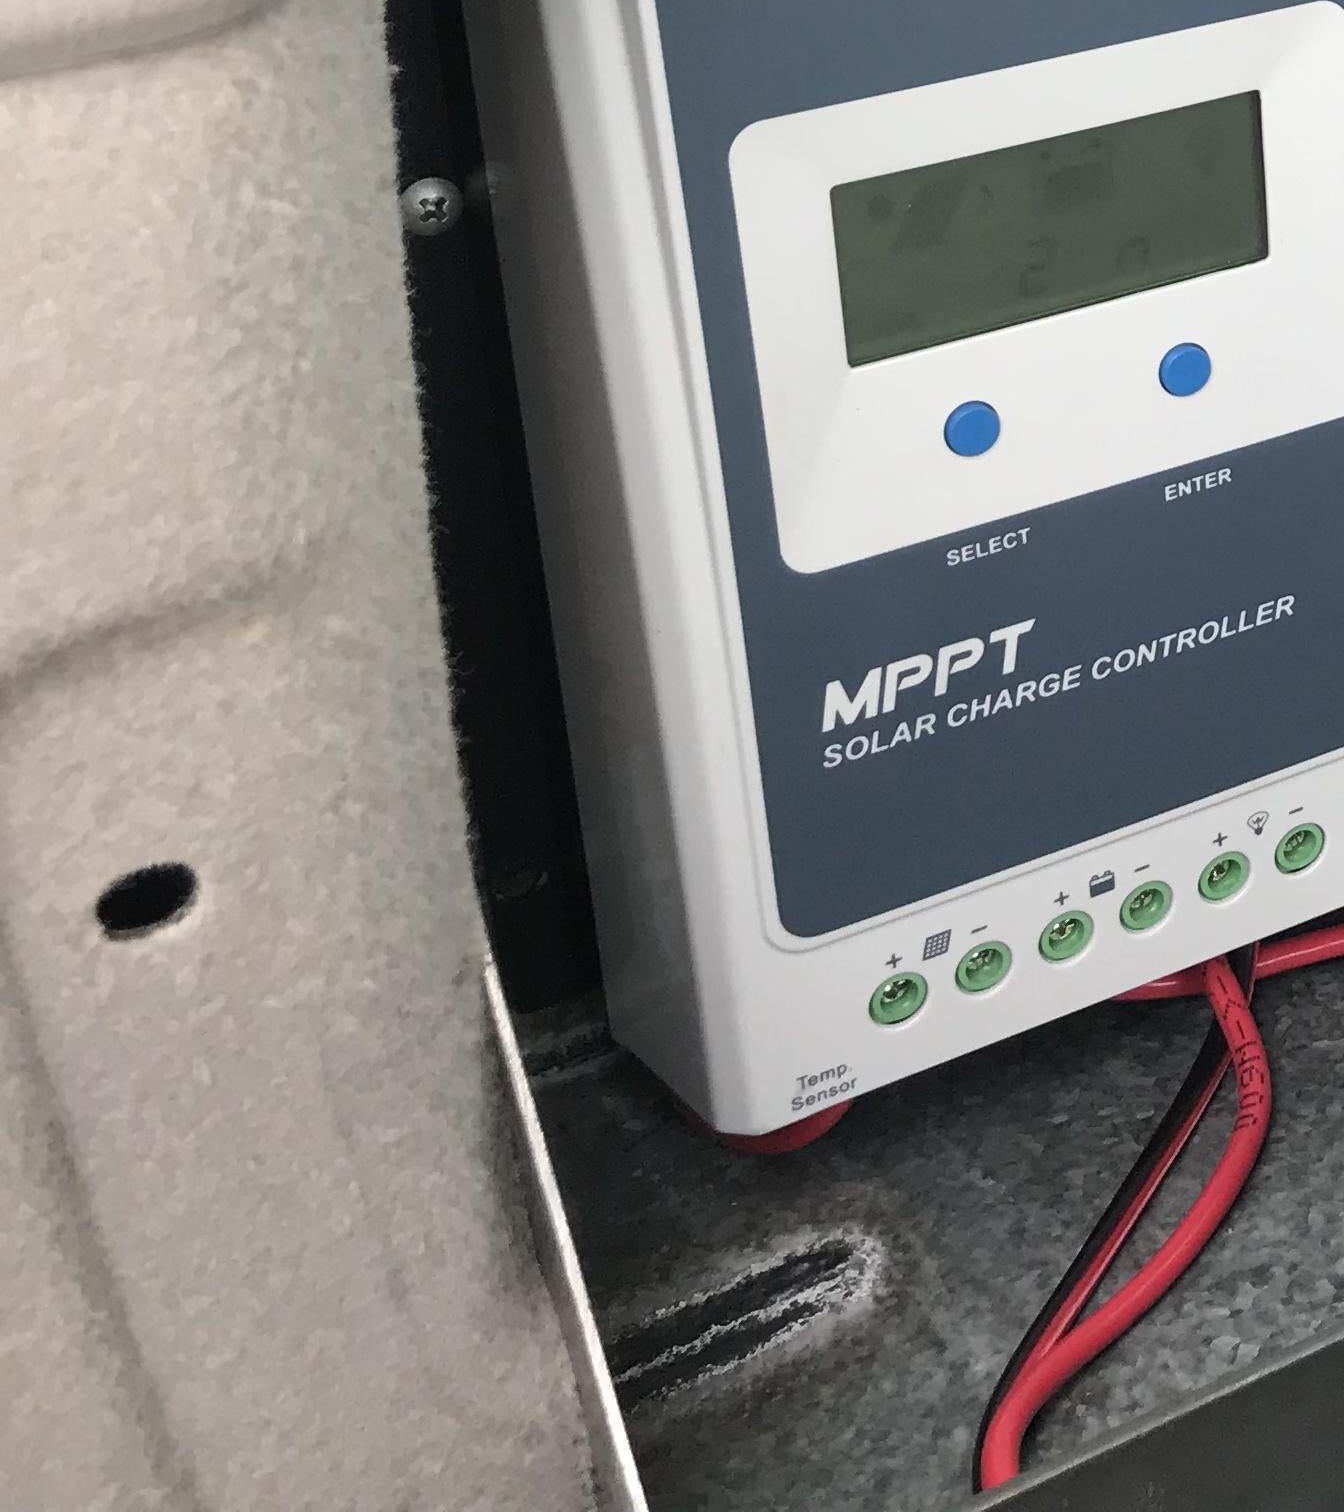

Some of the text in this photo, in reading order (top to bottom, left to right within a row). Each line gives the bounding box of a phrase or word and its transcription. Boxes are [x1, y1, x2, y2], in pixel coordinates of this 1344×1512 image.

[1164, 467, 1233, 502] ENTER
[946, 527, 1031, 567] SELECT
[820, 618, 1037, 733] MPPT
[822, 595, 1297, 769] SOLAR CHARGE CONTROLLER
[790, 1076, 859, 1114] Sensor
